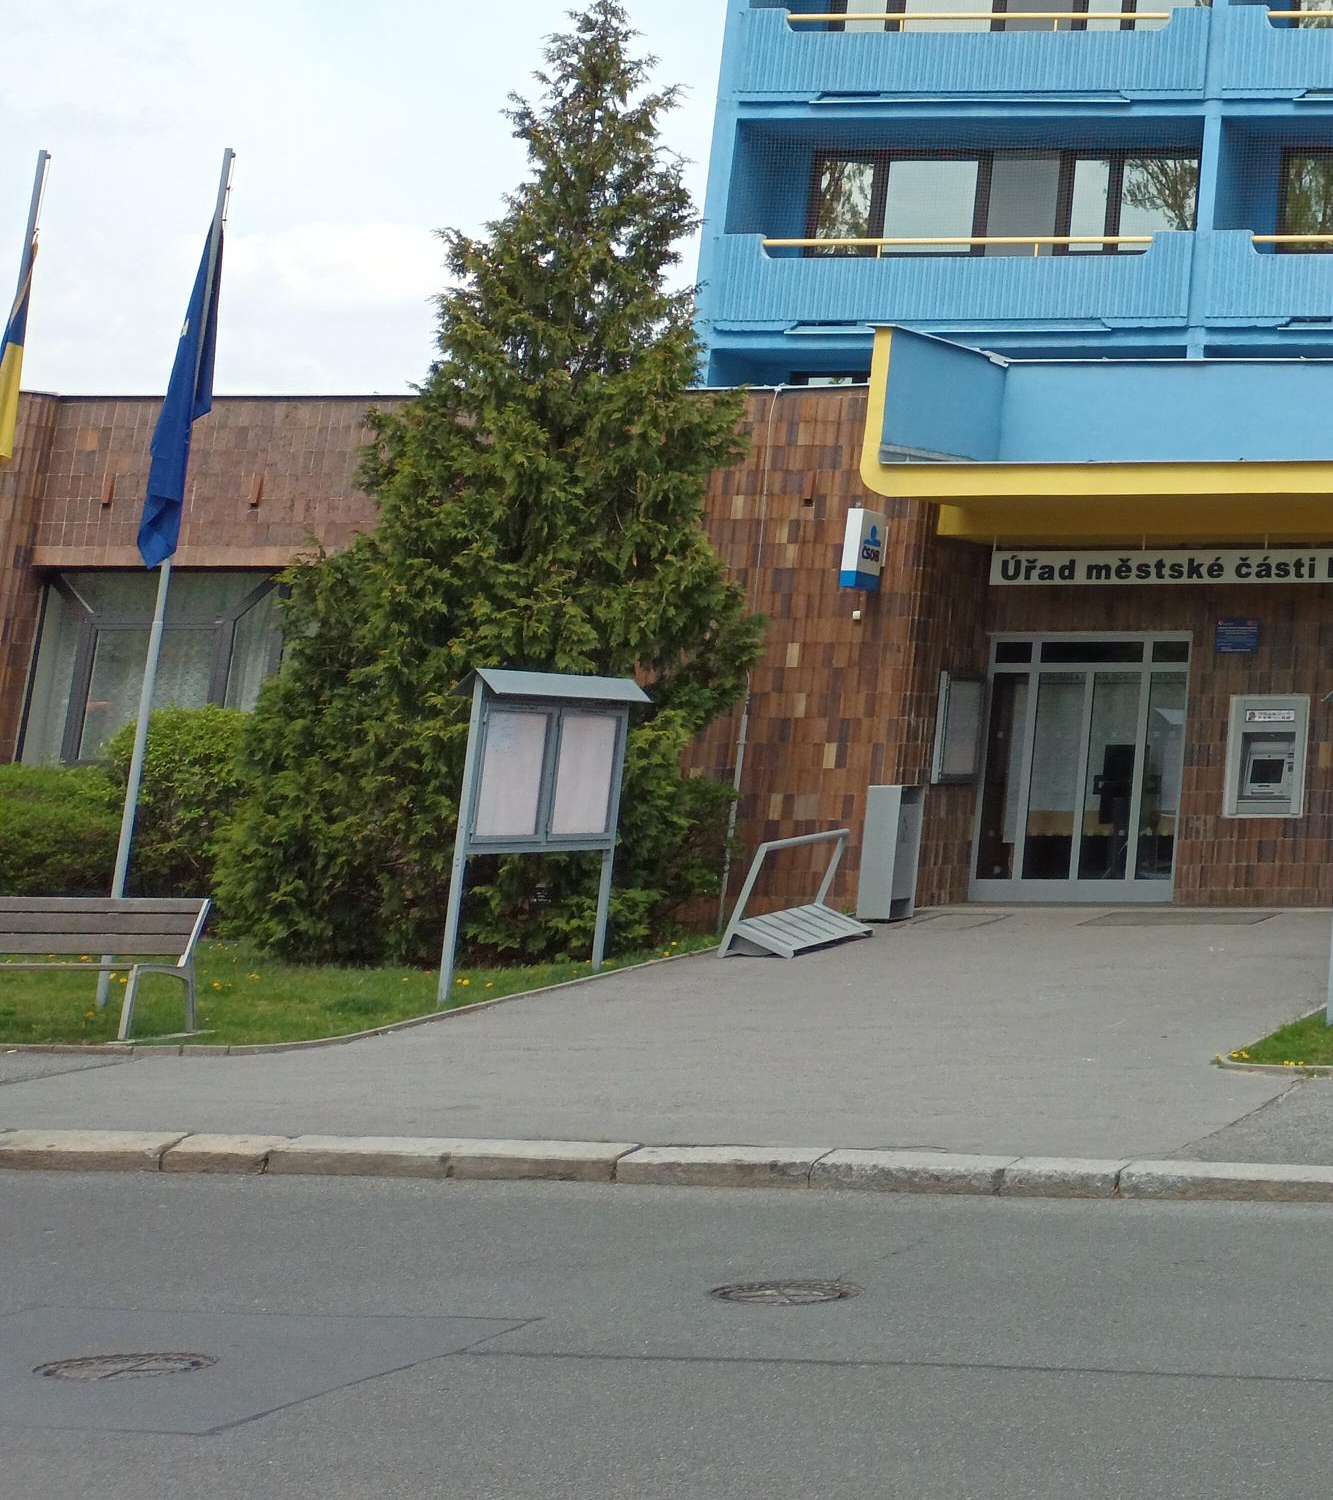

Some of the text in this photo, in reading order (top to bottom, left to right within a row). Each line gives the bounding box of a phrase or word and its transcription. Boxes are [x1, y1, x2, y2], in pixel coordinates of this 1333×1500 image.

[1001, 555, 1076, 581] Úřad
[1086, 556, 1224, 580] městské
[1235, 556, 1316, 579] části
